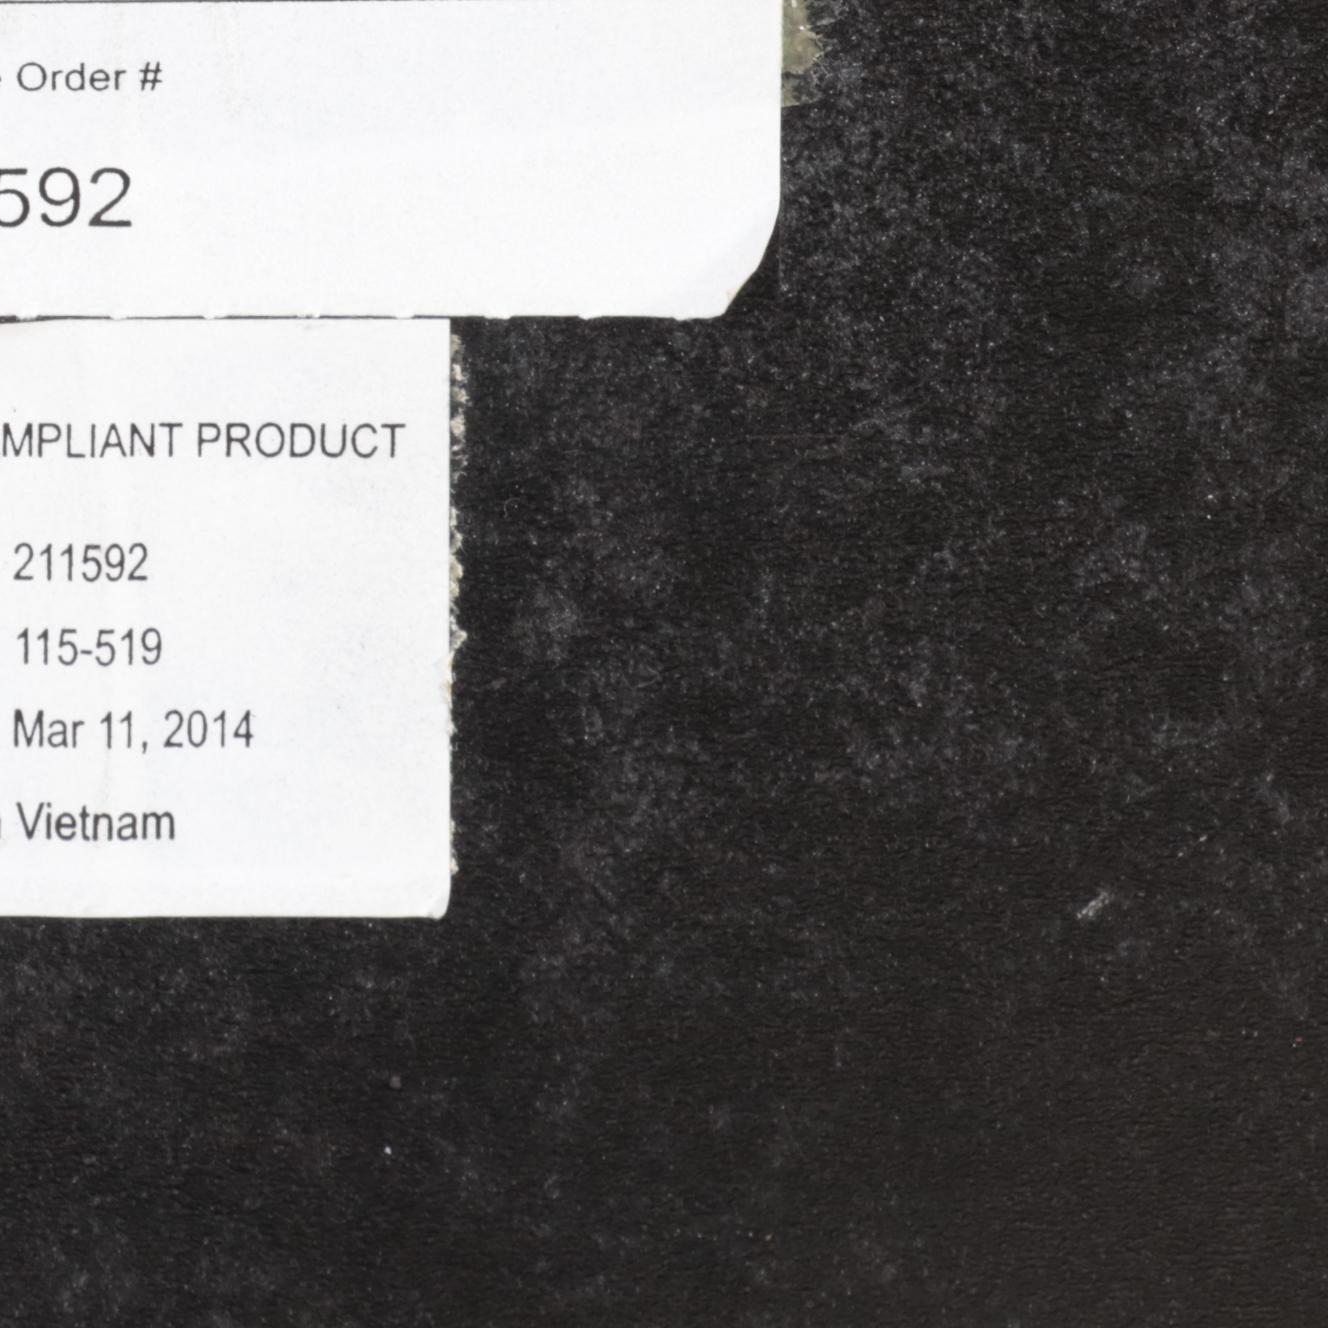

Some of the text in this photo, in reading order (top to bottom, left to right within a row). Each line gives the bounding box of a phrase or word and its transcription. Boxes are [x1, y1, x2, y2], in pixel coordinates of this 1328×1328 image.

[17, 62, 126, 91] Order
[139, 62, 162, 91] #
[198, 422, 406, 458] PRODUCT
[14, 543, 147, 582] 211592
[18, 628, 162, 667] 115-519
[14, 709, 84, 748] Mar
[101, 711, 147, 753] 11,
[164, 710, 253, 748] 2014
[16, 802, 175, 841] Vietnam
